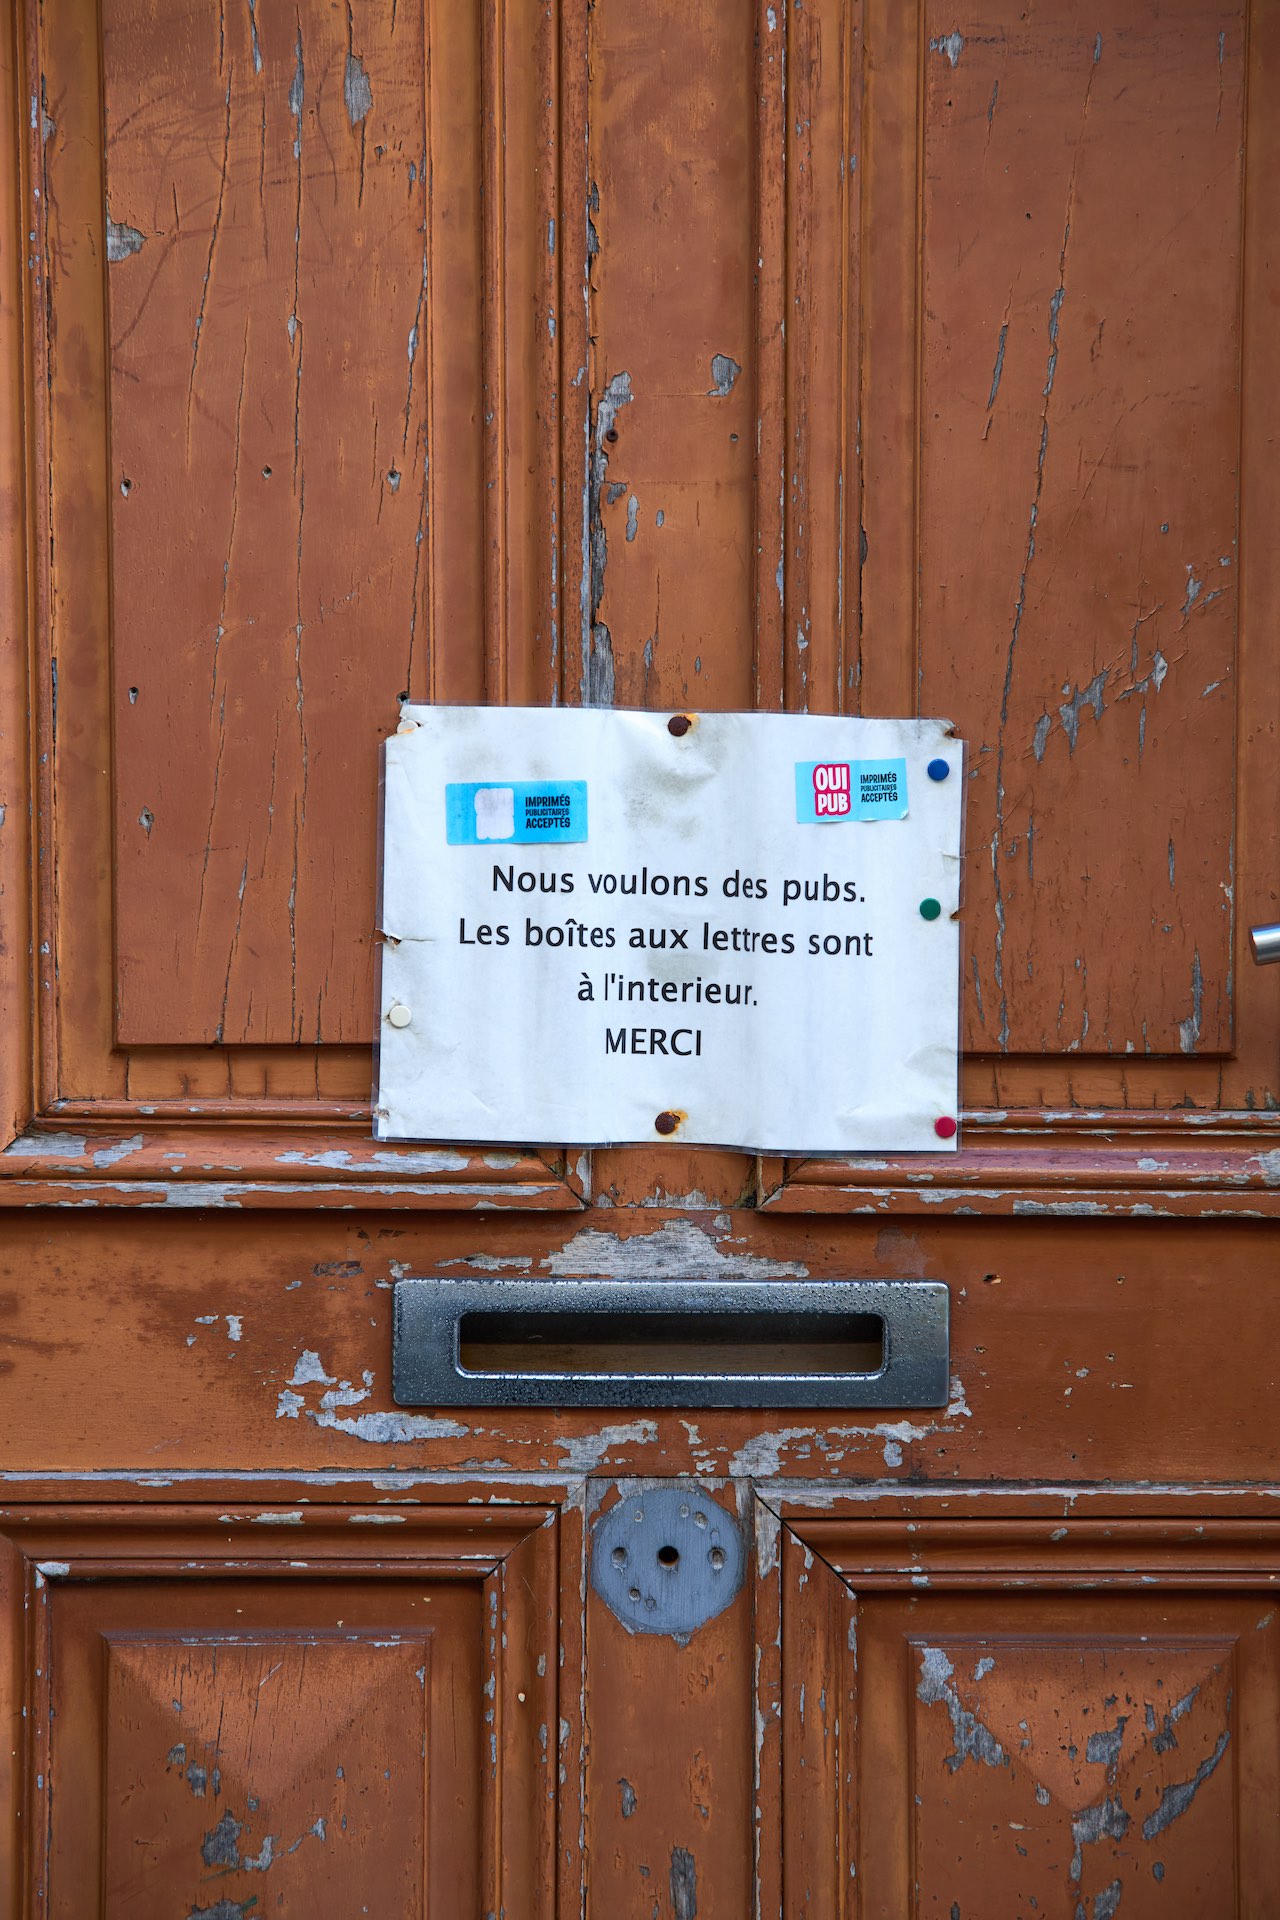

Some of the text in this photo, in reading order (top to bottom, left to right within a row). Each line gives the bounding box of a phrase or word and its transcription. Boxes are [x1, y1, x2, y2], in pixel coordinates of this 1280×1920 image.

[815, 766, 848, 791] OUI
[860, 772, 897, 784] IMPRIMÉS
[860, 783, 897, 792] PUBLICITAIRES
[861, 790, 898, 803] ACCEPTÉS
[525, 794, 571, 807] IMPRIMÉS
[817, 792, 849, 813] PUB
[525, 807, 570, 817] PUBLICITAIRES
[525, 814, 571, 829] ACCEPTÉS
[493, 866, 864, 906] Nous voulons des pubs.
[460, 918, 873, 956] Les boîtes aux lettres sont
[578, 973, 756, 1005] à l'interieur.
[606, 1029, 701, 1055] MERCI
